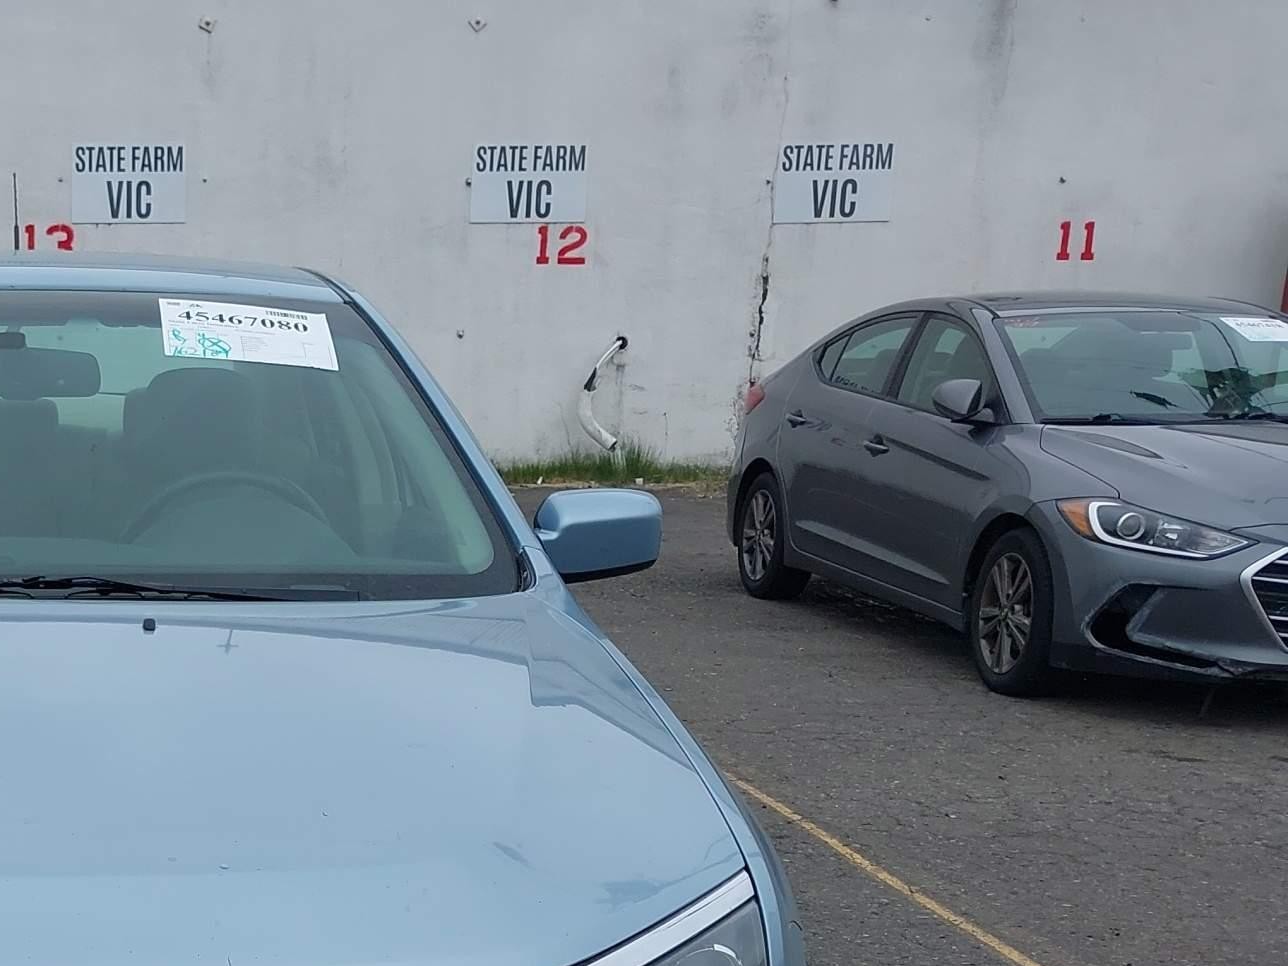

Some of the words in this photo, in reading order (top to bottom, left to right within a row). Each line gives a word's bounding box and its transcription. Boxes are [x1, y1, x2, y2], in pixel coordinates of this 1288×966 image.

[75, 146, 125, 172] STATE
[131, 146, 184, 172] FARM
[476, 146, 528, 172] STATE
[533, 146, 586, 172] FARM
[782, 144, 835, 171] STATE
[839, 144, 894, 171] FARM
[107, 180, 152, 218] VIC
[507, 180, 552, 218] VIC
[813, 179, 858, 218] VIC
[536, 225, 588, 266] 12
[1056, 221, 1095, 262] 11
[178, 310, 309, 333] 45467080
